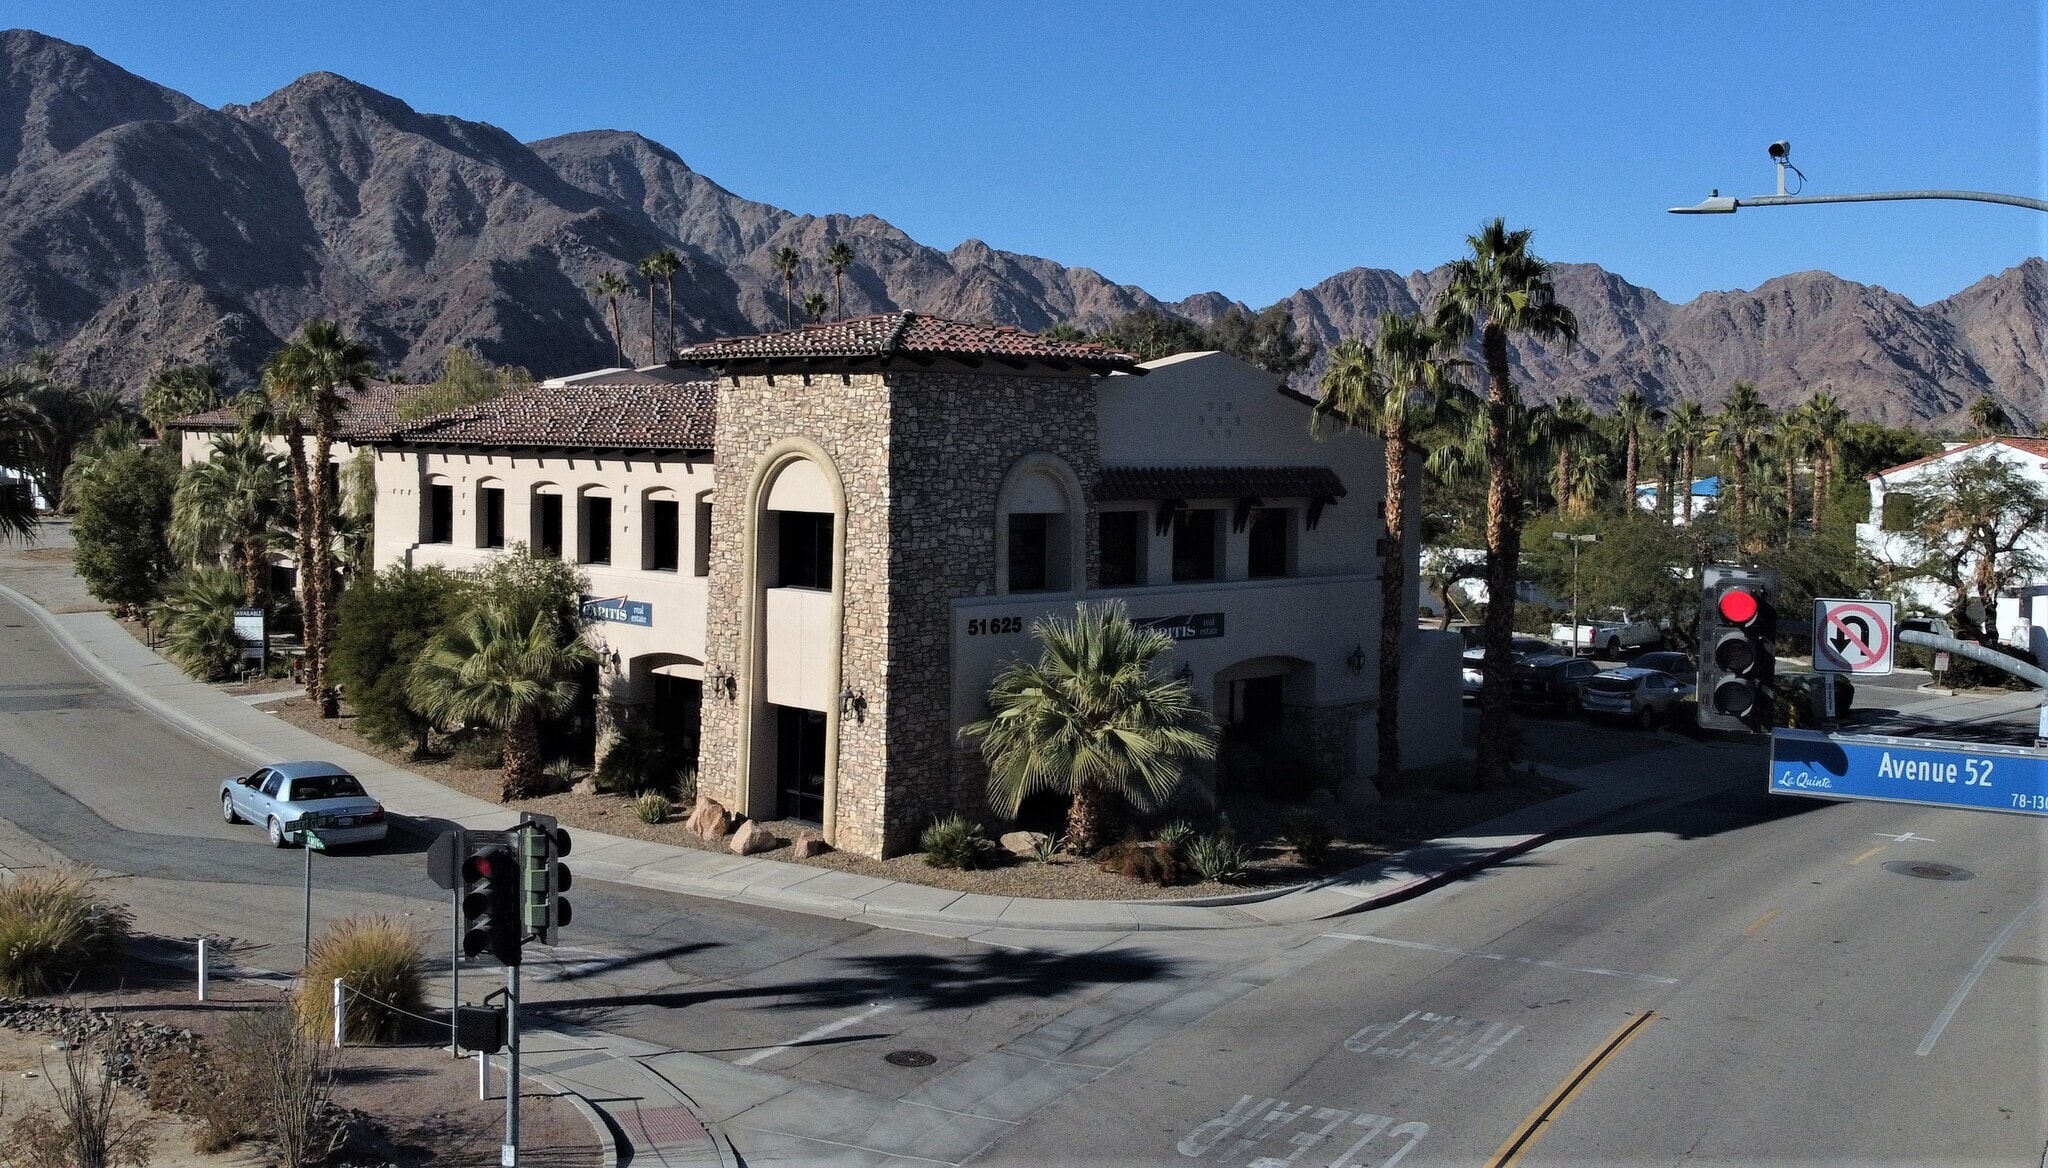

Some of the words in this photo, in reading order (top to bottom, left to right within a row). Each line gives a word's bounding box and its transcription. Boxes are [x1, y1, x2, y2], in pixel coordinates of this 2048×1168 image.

[633, 605, 644, 615] real
[630, 614, 647, 624] estate
[968, 616, 1022, 635] 51625
[1203, 617, 1215, 626] real
[1199, 627, 1218, 636] estate
[1878, 752, 1958, 784] Avenue
[1964, 758, 1994, 787] 52
[1778, 770, 1795, 787] La
[1796, 771, 1832, 789] Quinta
[286, 819, 309, 831] DESERT
[1344, 1009, 1524, 1071] KEEP
[1177, 1094, 1430, 1168] CLEAR
